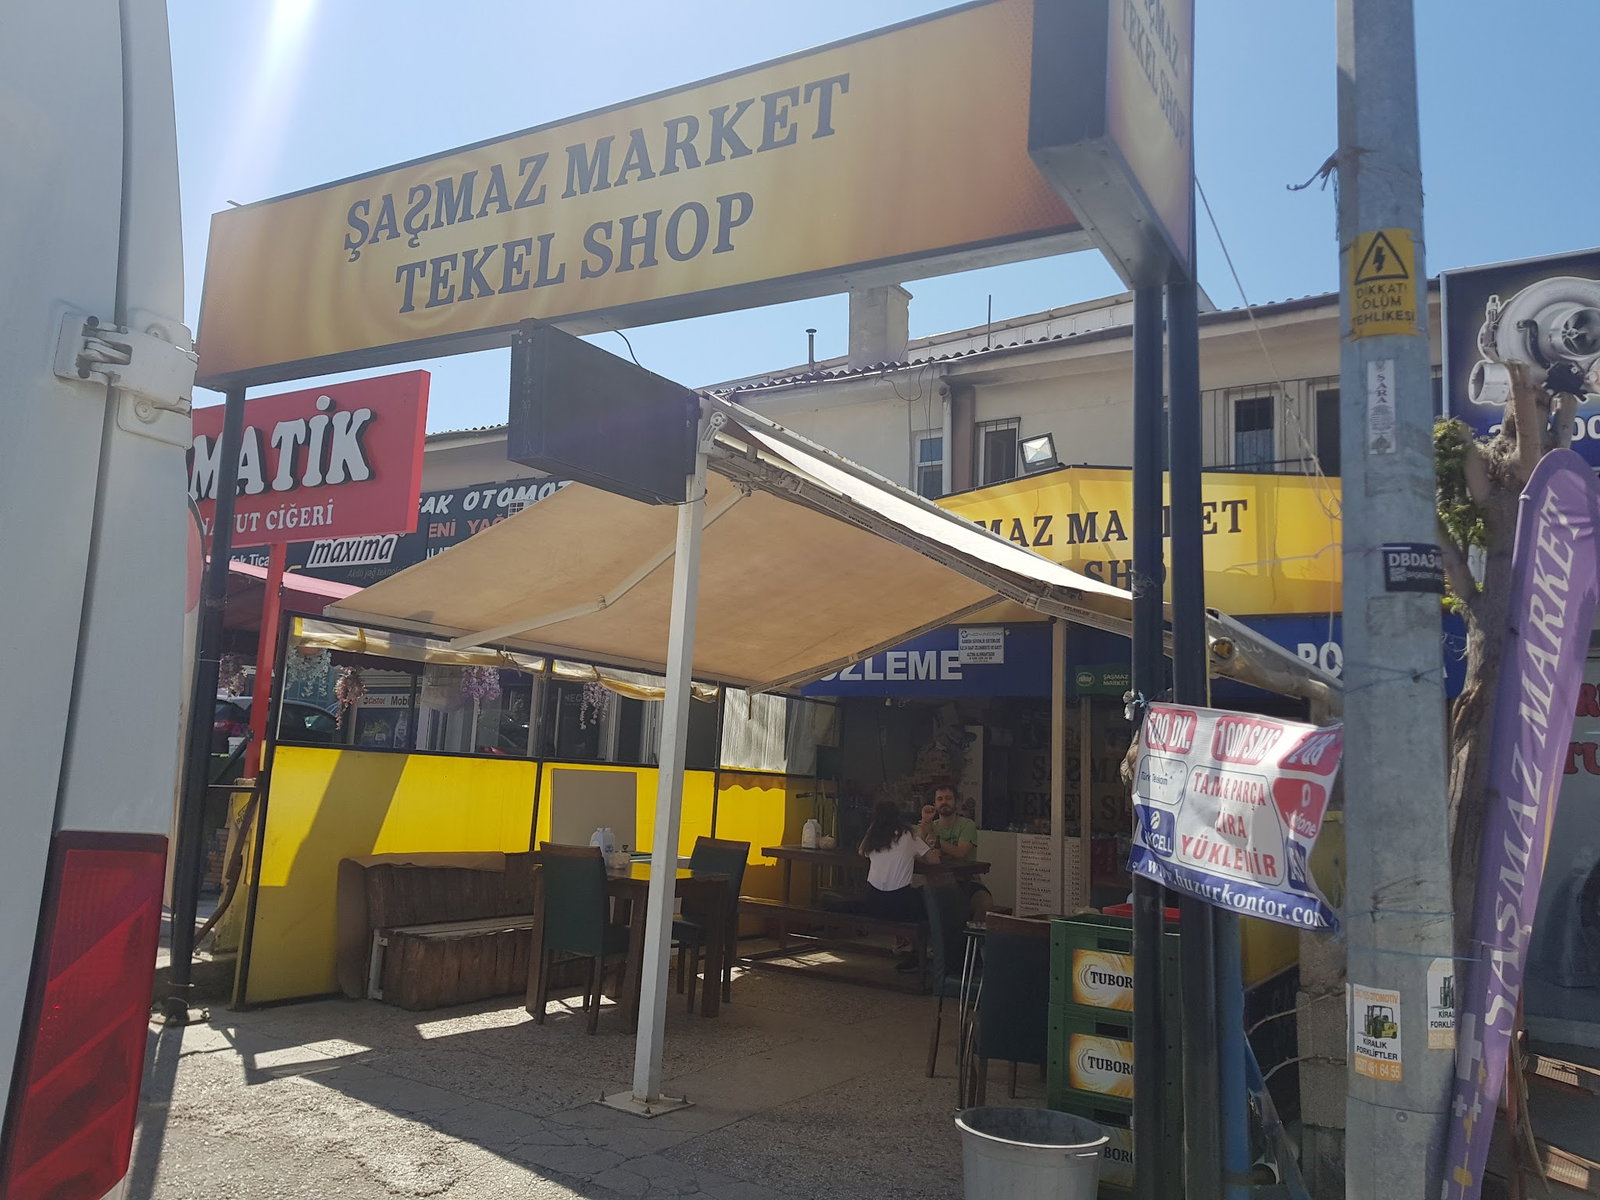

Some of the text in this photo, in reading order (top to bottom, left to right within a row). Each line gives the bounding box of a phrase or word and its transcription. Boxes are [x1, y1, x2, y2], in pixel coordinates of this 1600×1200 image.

[561, 72, 850, 200] MARKET
[395, 191, 754, 314] TEKEL SHOP
[265, 498, 335, 531] CİĞERİ
[418, 494, 455, 515] AK
[1066, 499, 1248, 546] MAET
[309, 534, 398, 567] maxima
[1529, 485, 1581, 749] MARKET
[390, 696, 409, 705] Mob
[1147, 711, 1170, 746] 500
[1193, 772, 1223, 798] TAM
[1230, 779, 1267, 811] PARÇA
[1147, 860, 1329, 928] w.huzurkontor.com
[1090, 971, 1133, 990] TUBOR
[1430, 1020, 1456, 1029] FORKLİF
[1088, 1056, 1133, 1076] TUBOR
[1103, 1146, 1133, 1165] BOR
